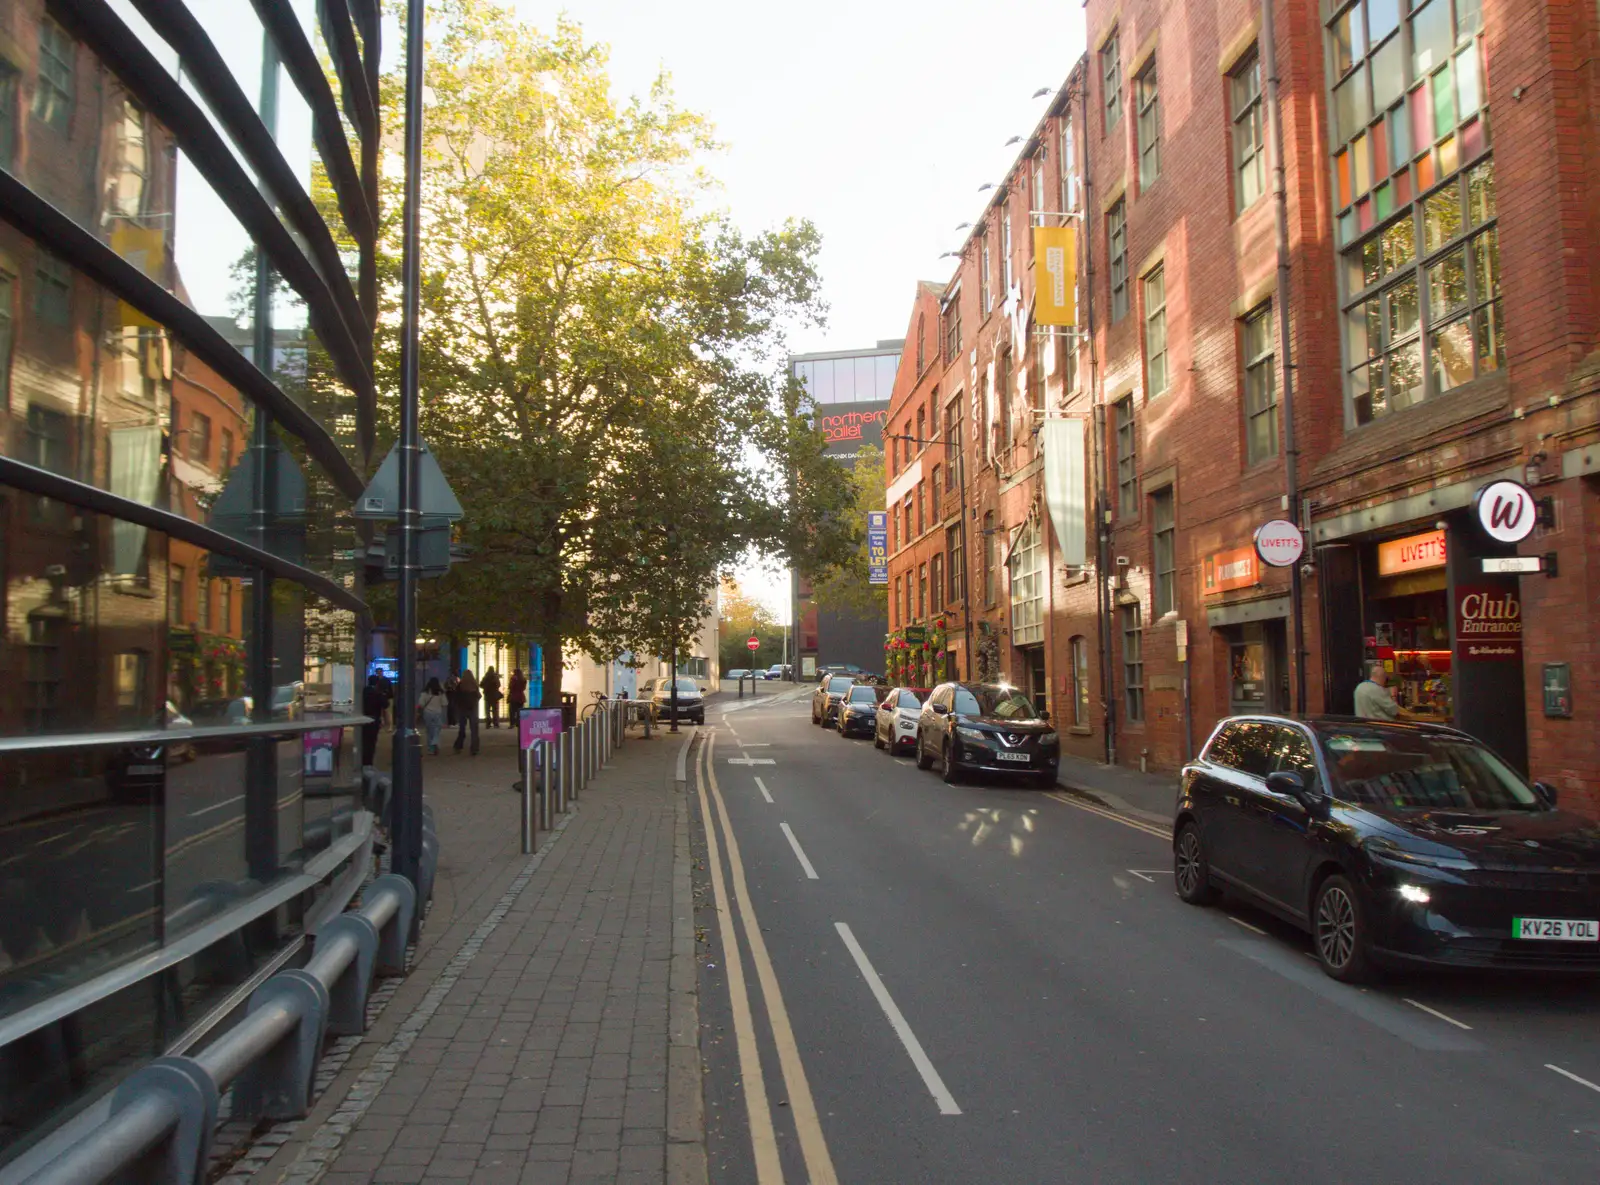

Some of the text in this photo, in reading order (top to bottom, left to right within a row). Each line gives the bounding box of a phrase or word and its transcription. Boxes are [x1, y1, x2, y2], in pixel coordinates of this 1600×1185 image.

[822, 410, 887, 427] northern
[822, 424, 862, 440] ballet
[871, 546, 885, 556] TO
[1261, 538, 1300, 549] LIVETT'S
[1400, 536, 1446, 563] LIVETT'S
[869, 556, 887, 566] LET
[1499, 559, 1524, 572] Club
[1461, 592, 1520, 619] Club
[1462, 619, 1522, 633] Entrance
[1522, 920, 1596, 937] KV26 YOL
